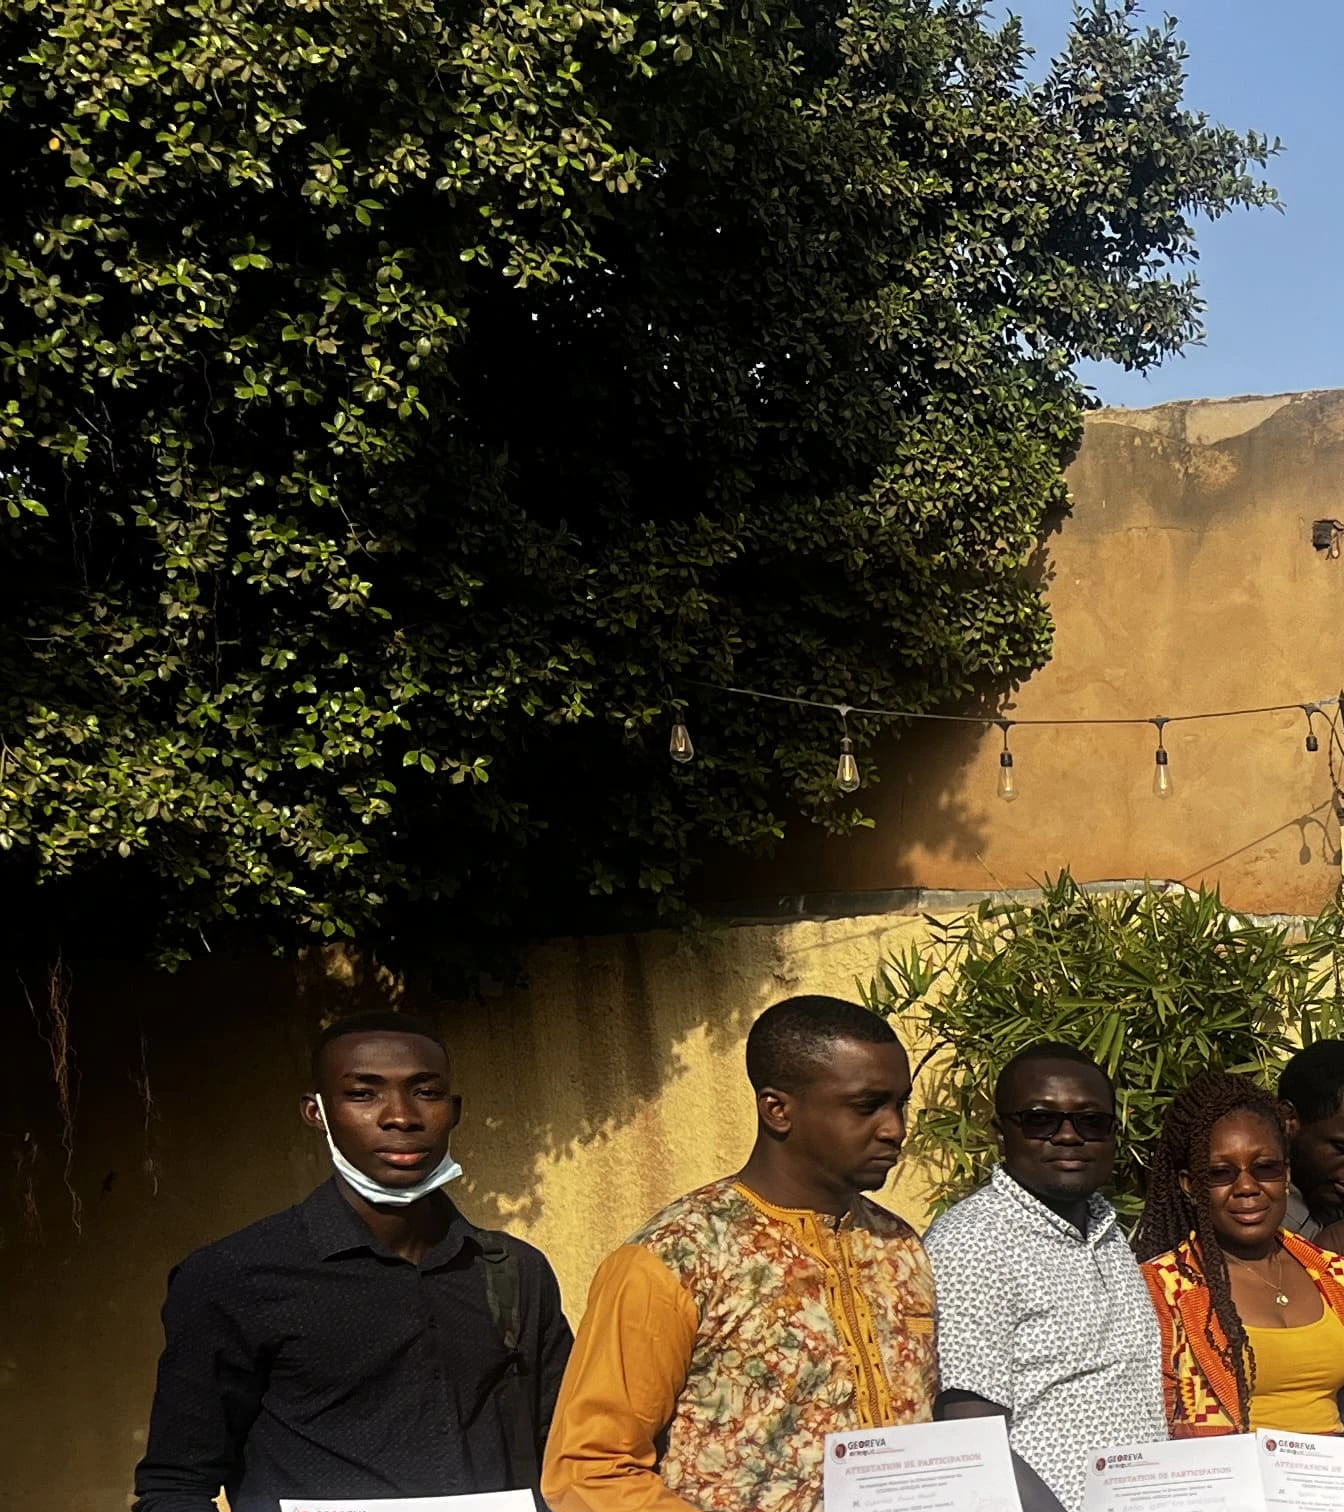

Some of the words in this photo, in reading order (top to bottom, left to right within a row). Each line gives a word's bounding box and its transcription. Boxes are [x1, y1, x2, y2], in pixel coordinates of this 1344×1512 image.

[847, 1437, 887, 1450] GEOREVA
[1278, 1440, 1316, 1451] GEOREVA
[1107, 1452, 1144, 1464] GEOREVA
[845, 1460, 902, 1476] ATTESTATION
[904, 1459, 916, 1468] DE
[918, 1453, 982, 1467] PARTICIPATION
